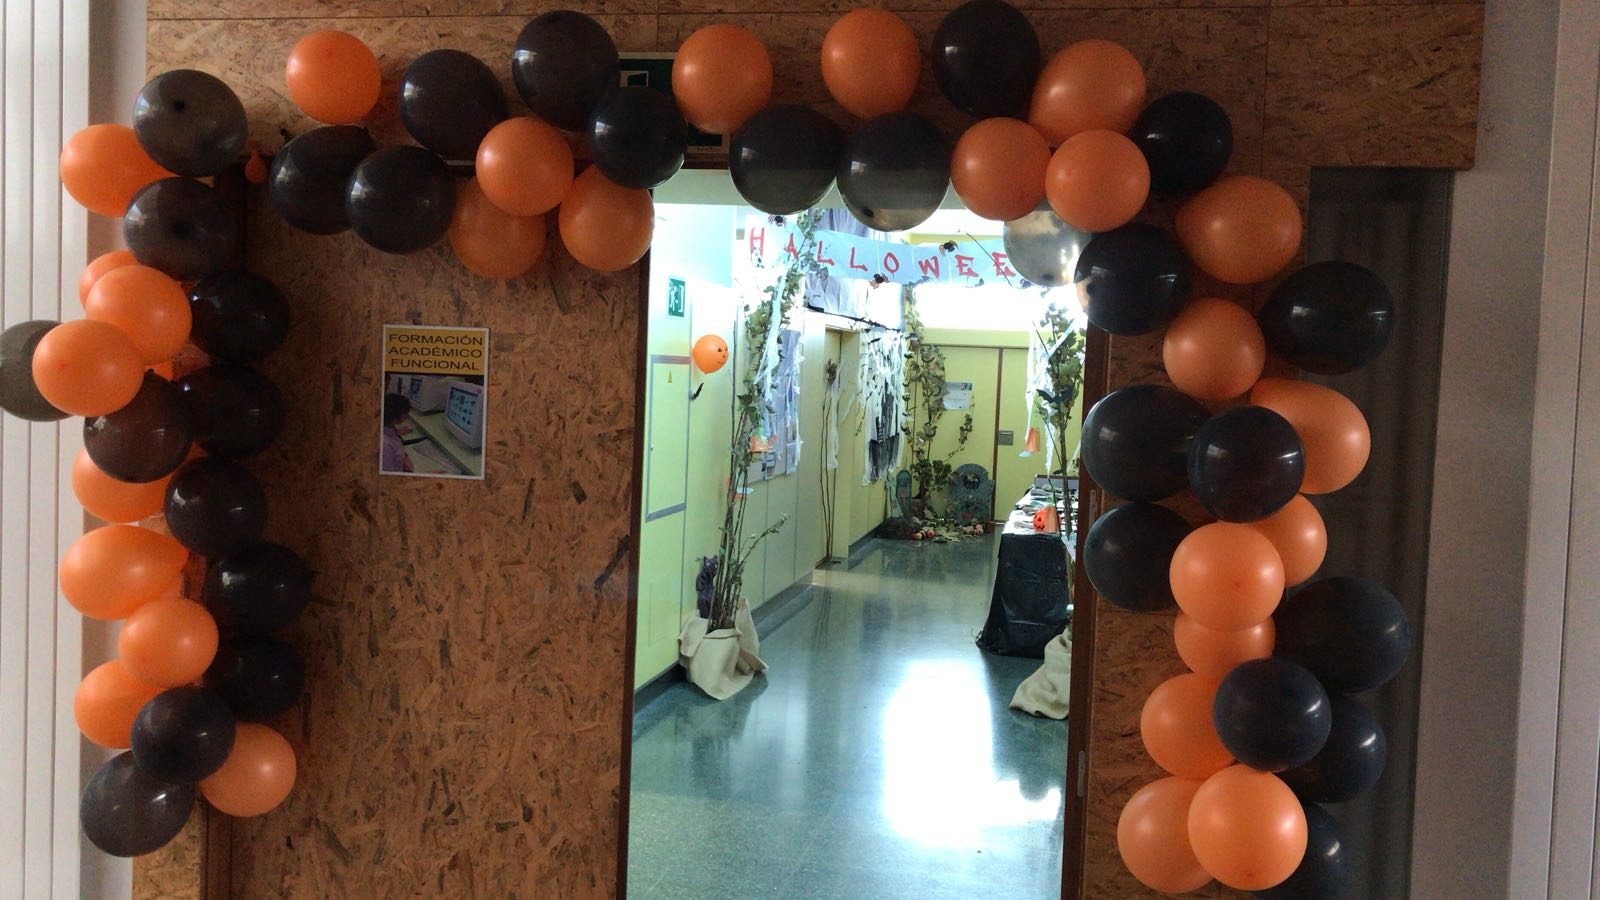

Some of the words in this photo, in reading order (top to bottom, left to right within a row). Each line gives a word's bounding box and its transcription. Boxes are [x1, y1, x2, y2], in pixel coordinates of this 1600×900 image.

[750, 226, 1016, 278] HALLOWEE
[389, 333, 483, 346] FORMACIÓN
[388, 346, 482, 358] ACADÉMICO
[391, 358, 480, 371] FUNCIONAL
